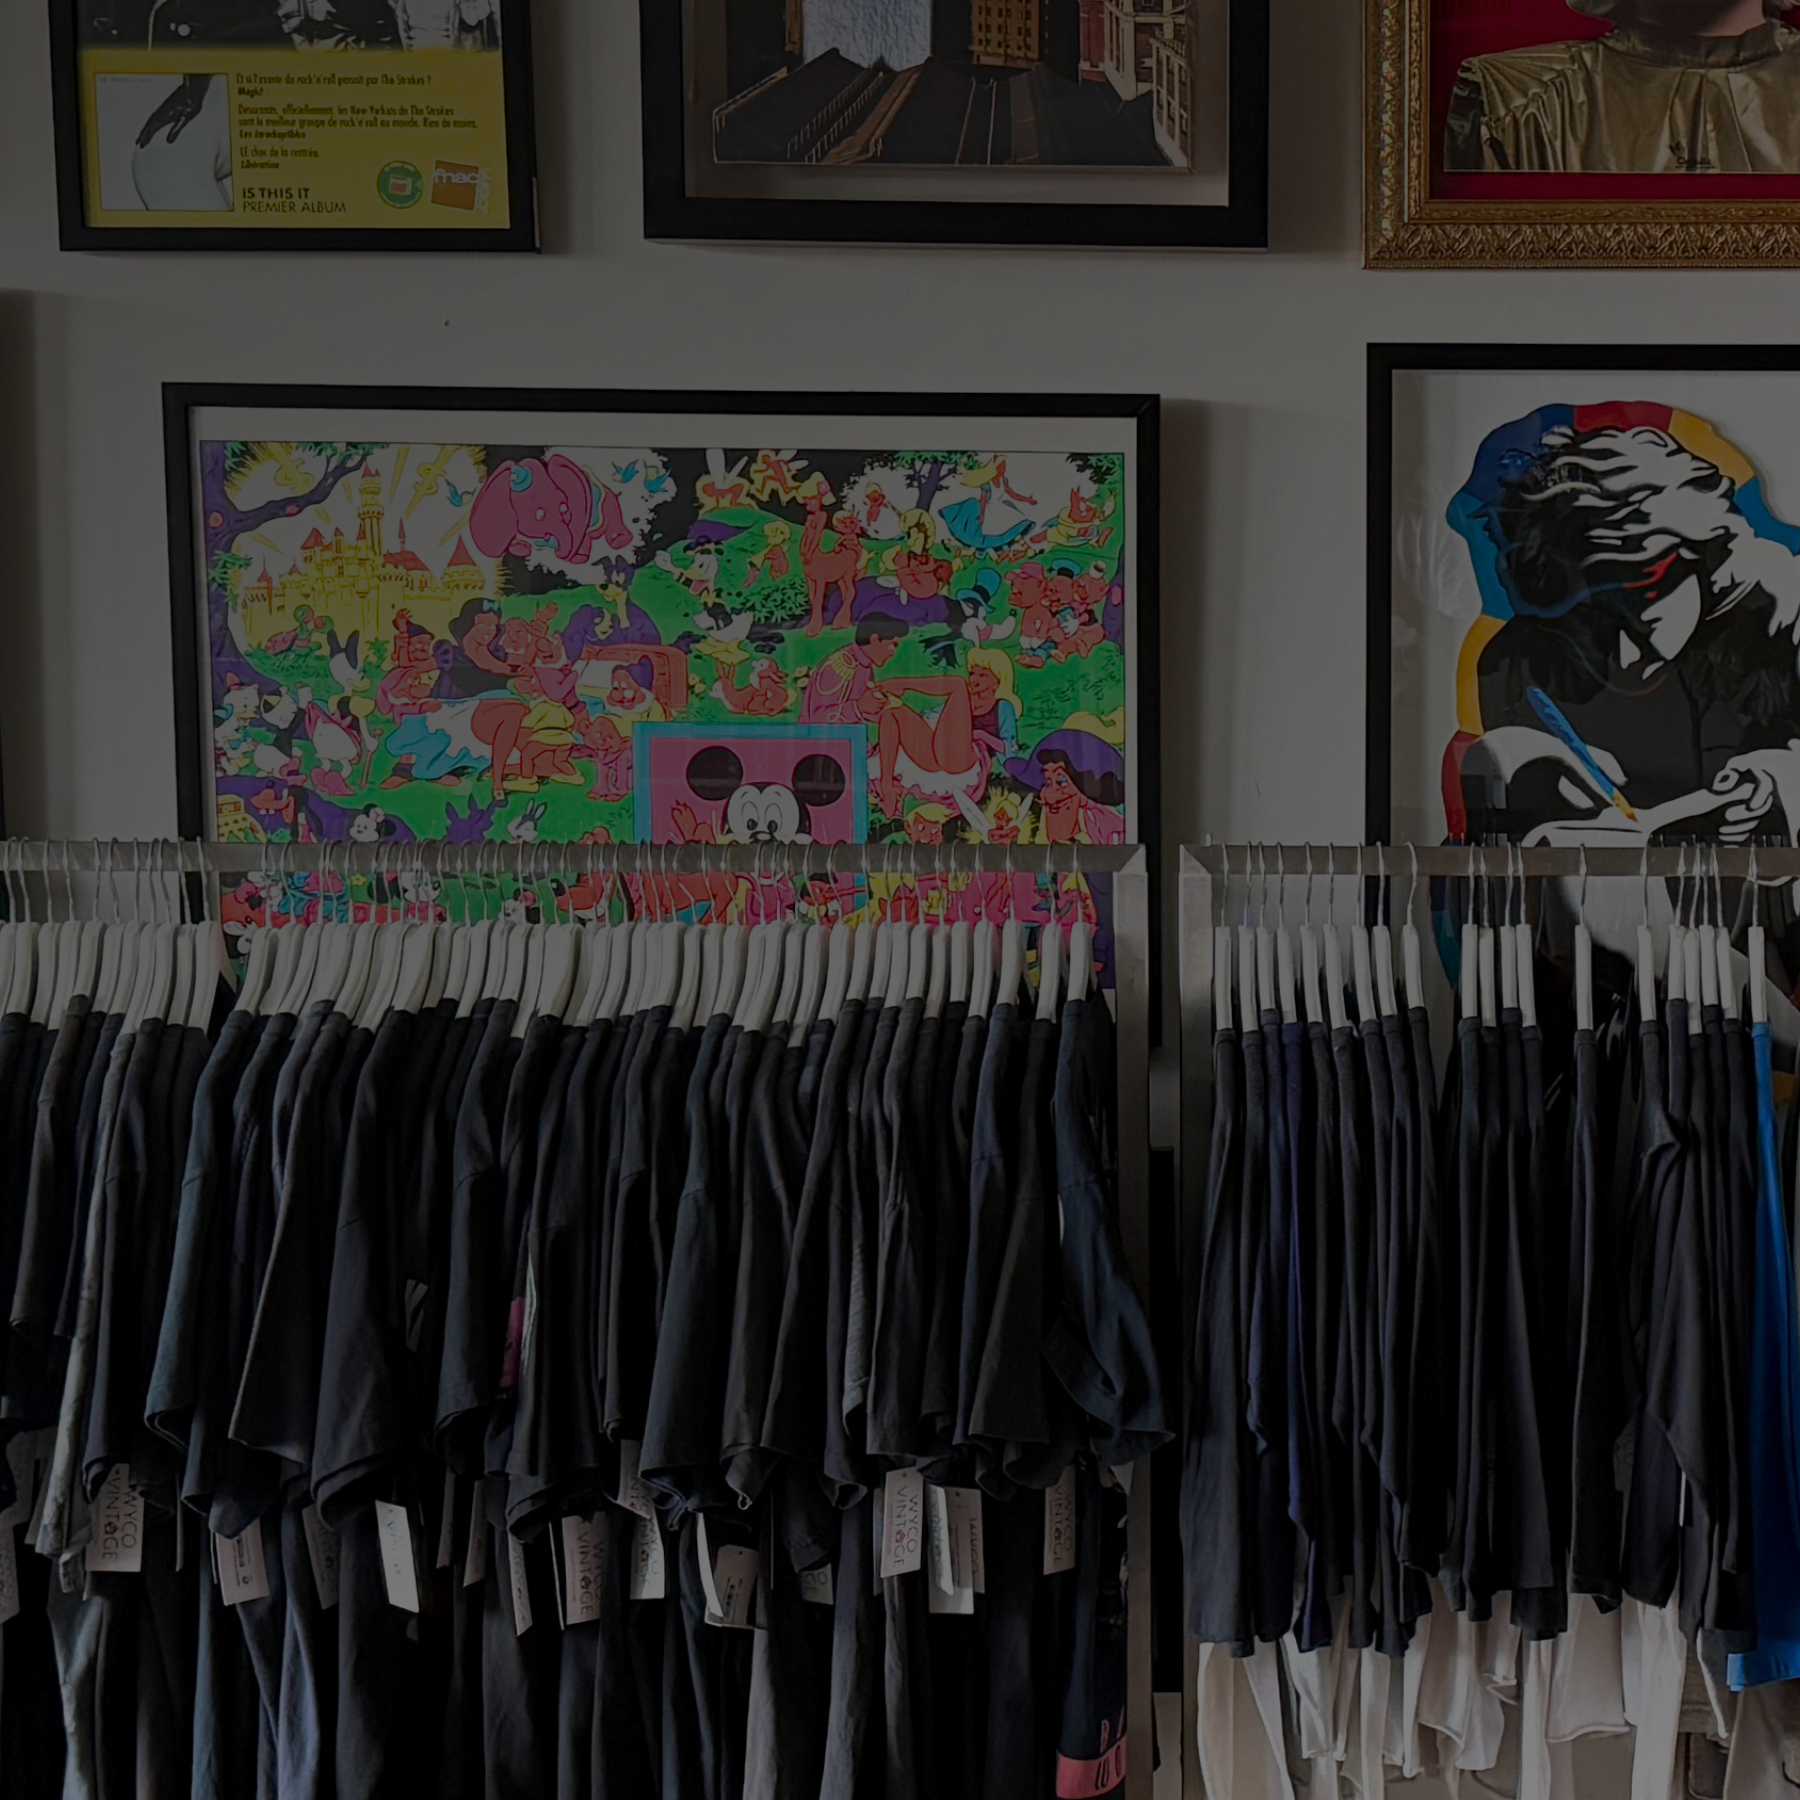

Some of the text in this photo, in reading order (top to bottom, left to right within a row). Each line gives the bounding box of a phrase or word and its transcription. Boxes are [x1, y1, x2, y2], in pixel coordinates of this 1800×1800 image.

[434, 168, 480, 184] fnac
[242, 187, 310, 199] IS THIS IT
[243, 200, 346, 213] PREMIER ALBUM
[906, 1493, 919, 1554] WYCO
